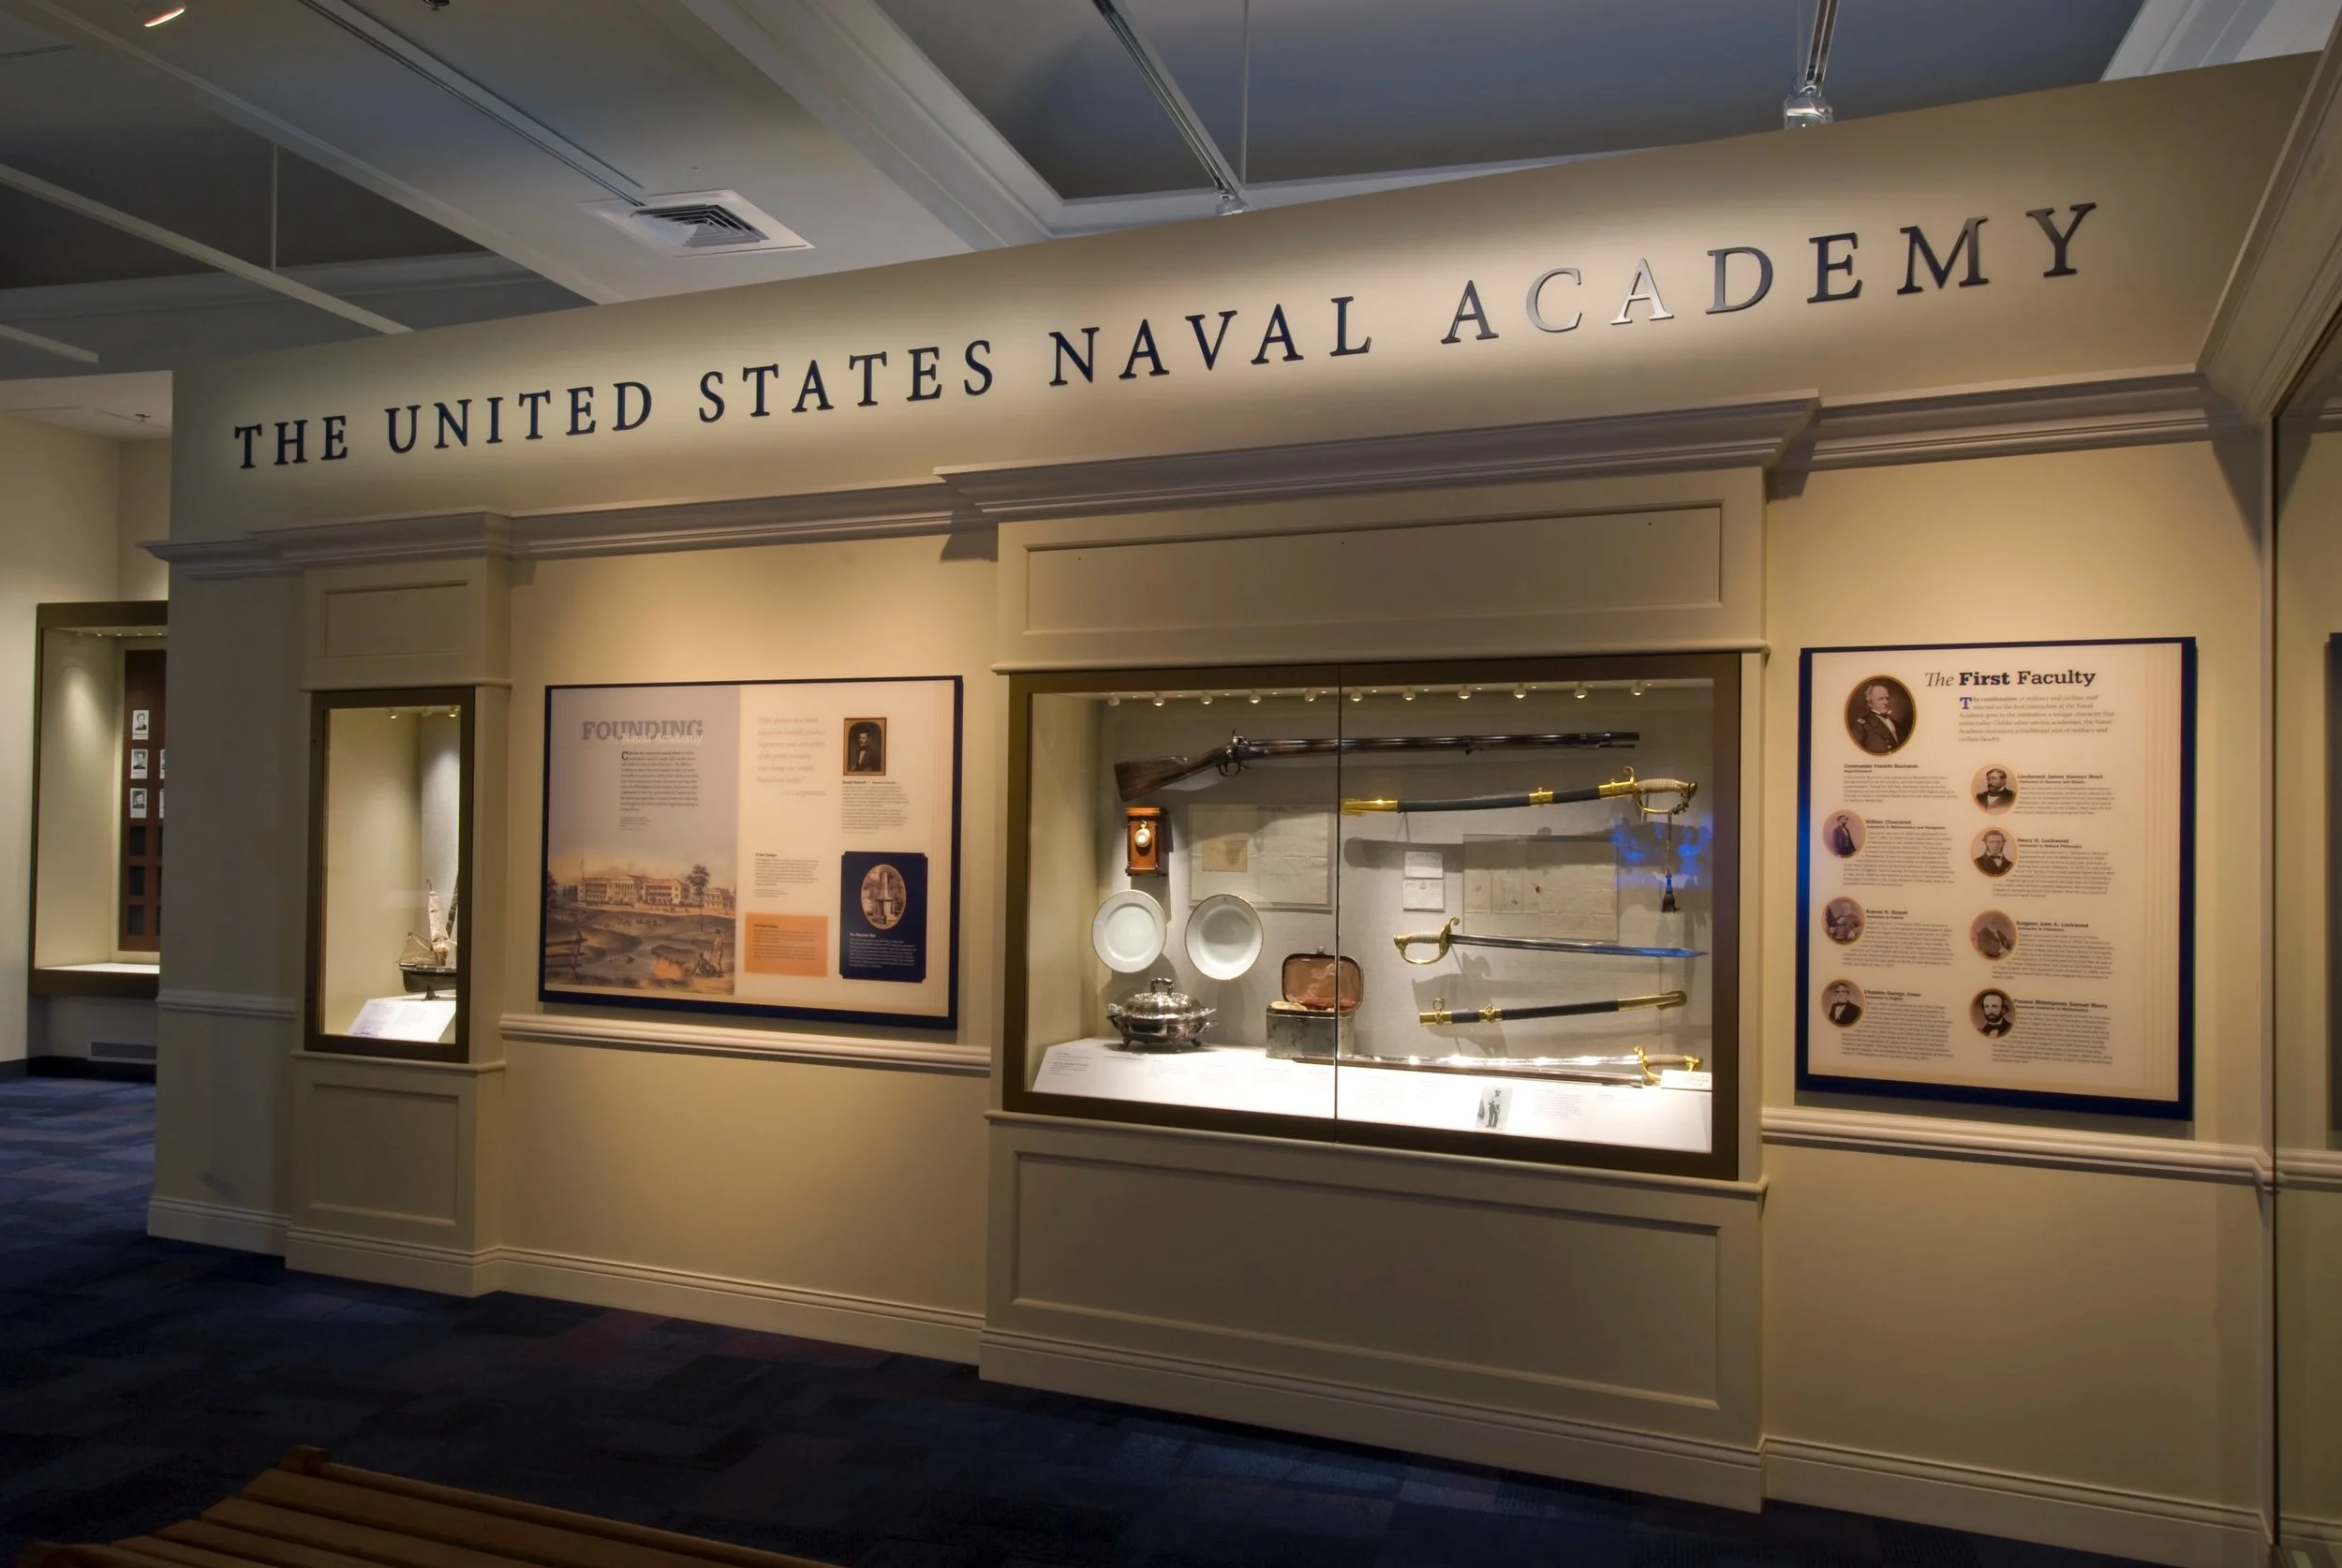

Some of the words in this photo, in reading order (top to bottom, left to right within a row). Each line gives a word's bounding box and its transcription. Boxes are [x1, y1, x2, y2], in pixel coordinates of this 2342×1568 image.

[234, 415, 348, 469] THE
[384, 381, 653, 454] UNITED
[698, 340, 993, 423] STATES
[1048, 296, 1371, 387] NAVAL
[1440, 201, 2097, 345] ACADEMY
[1925, 672, 1954, 687] The
[1958, 671, 2010, 686] First
[2017, 670, 2097, 688] Faculty
[581, 719, 704, 741] FOUNDING
